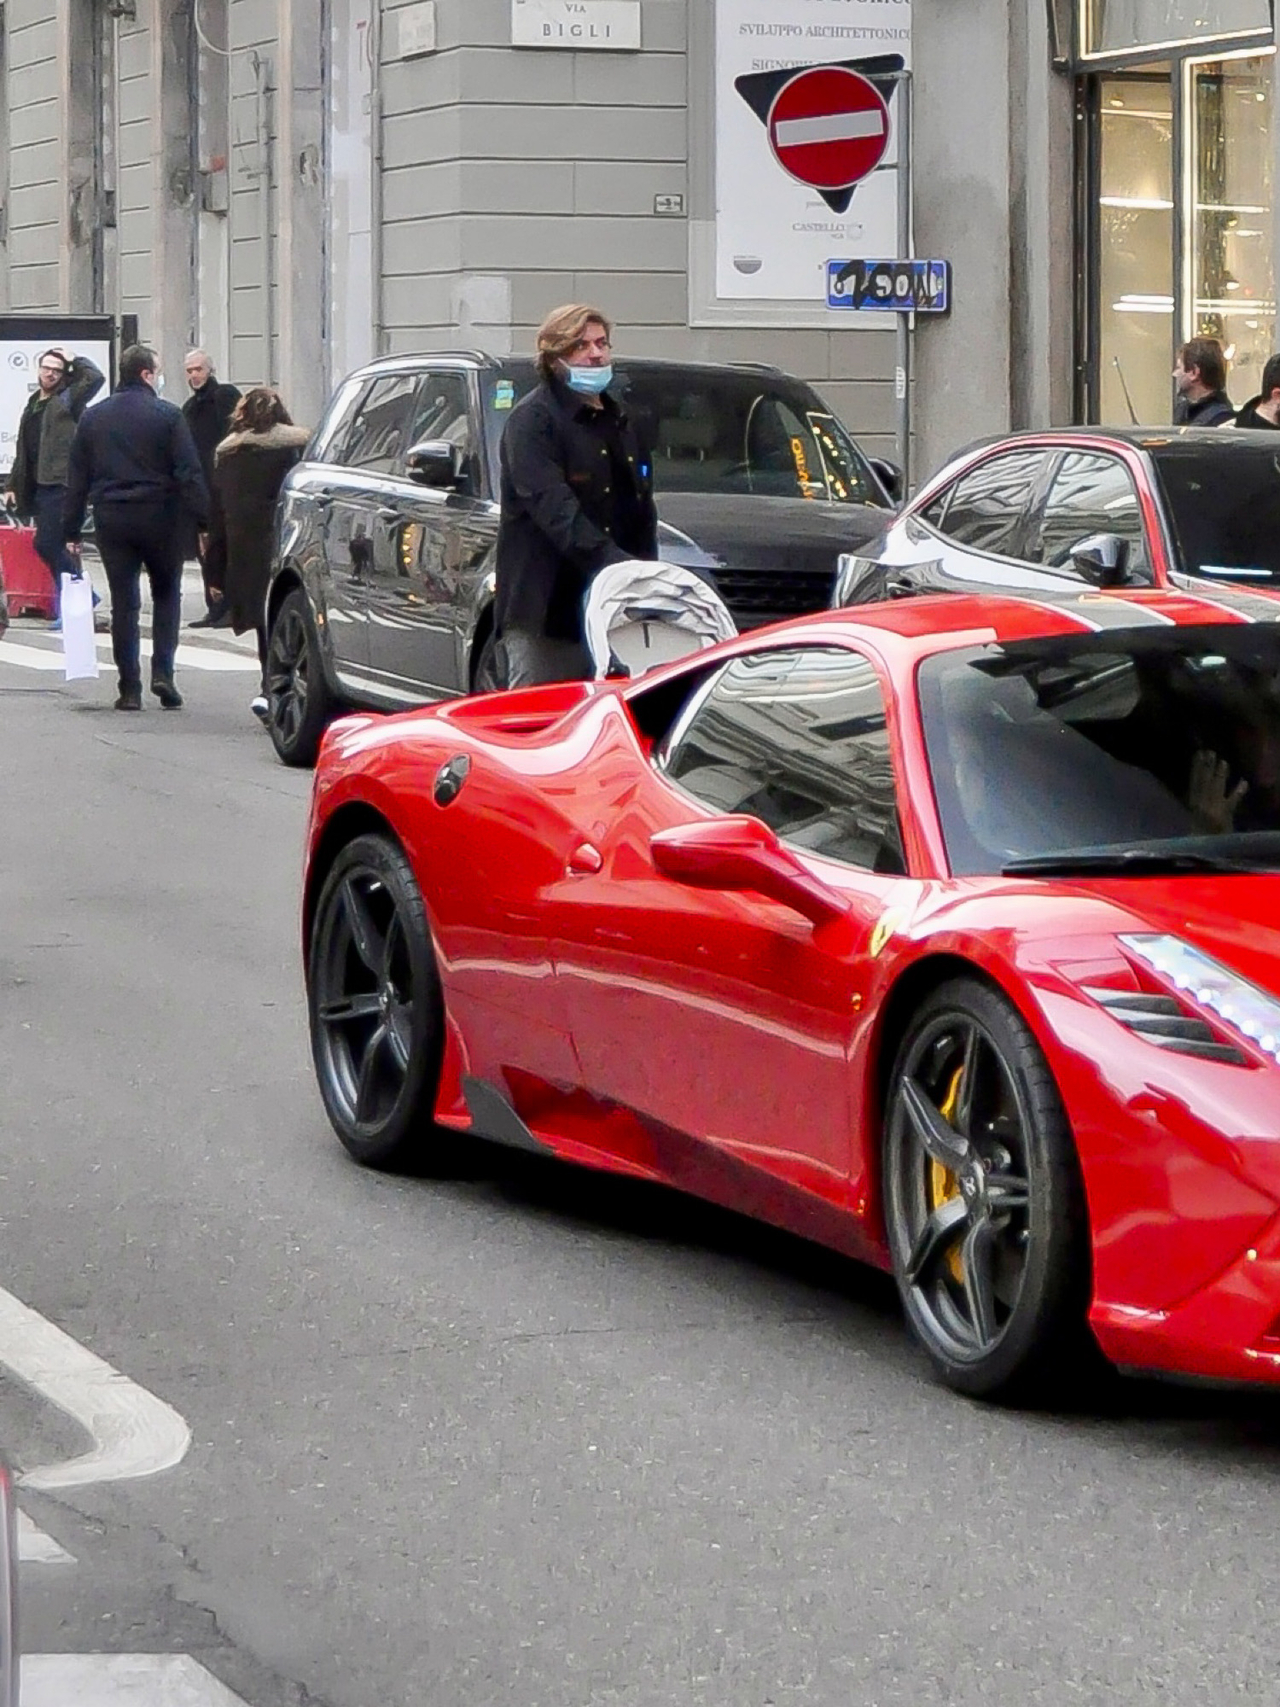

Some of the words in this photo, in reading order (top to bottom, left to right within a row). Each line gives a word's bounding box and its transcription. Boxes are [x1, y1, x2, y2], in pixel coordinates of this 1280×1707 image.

[566, 4, 586, 13] VIA
[543, 23, 610, 38] BIGLI
[739, 24, 803, 36] SVILUPPO
